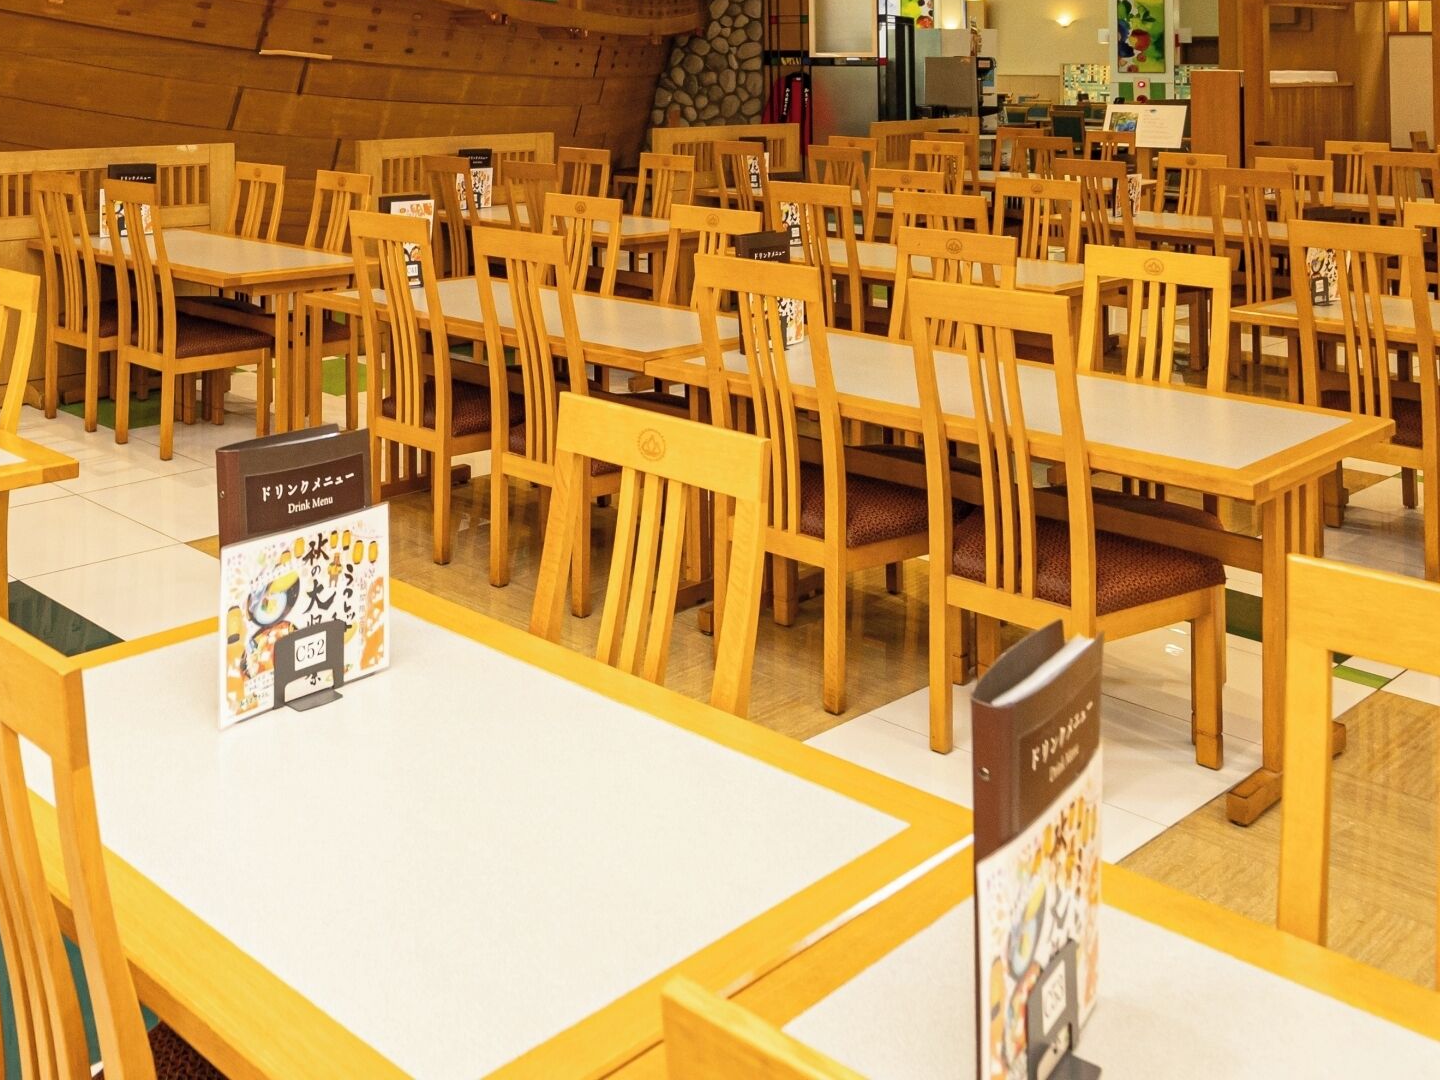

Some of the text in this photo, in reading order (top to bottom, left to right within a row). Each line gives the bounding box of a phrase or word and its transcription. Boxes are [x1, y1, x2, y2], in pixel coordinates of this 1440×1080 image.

[261, 471, 356, 503] ドリンクメニュー
[287, 494, 334, 514] Drink Menu
[295, 639, 326, 663] C52
[1031, 700, 1094, 772] ドリンクメニュー
